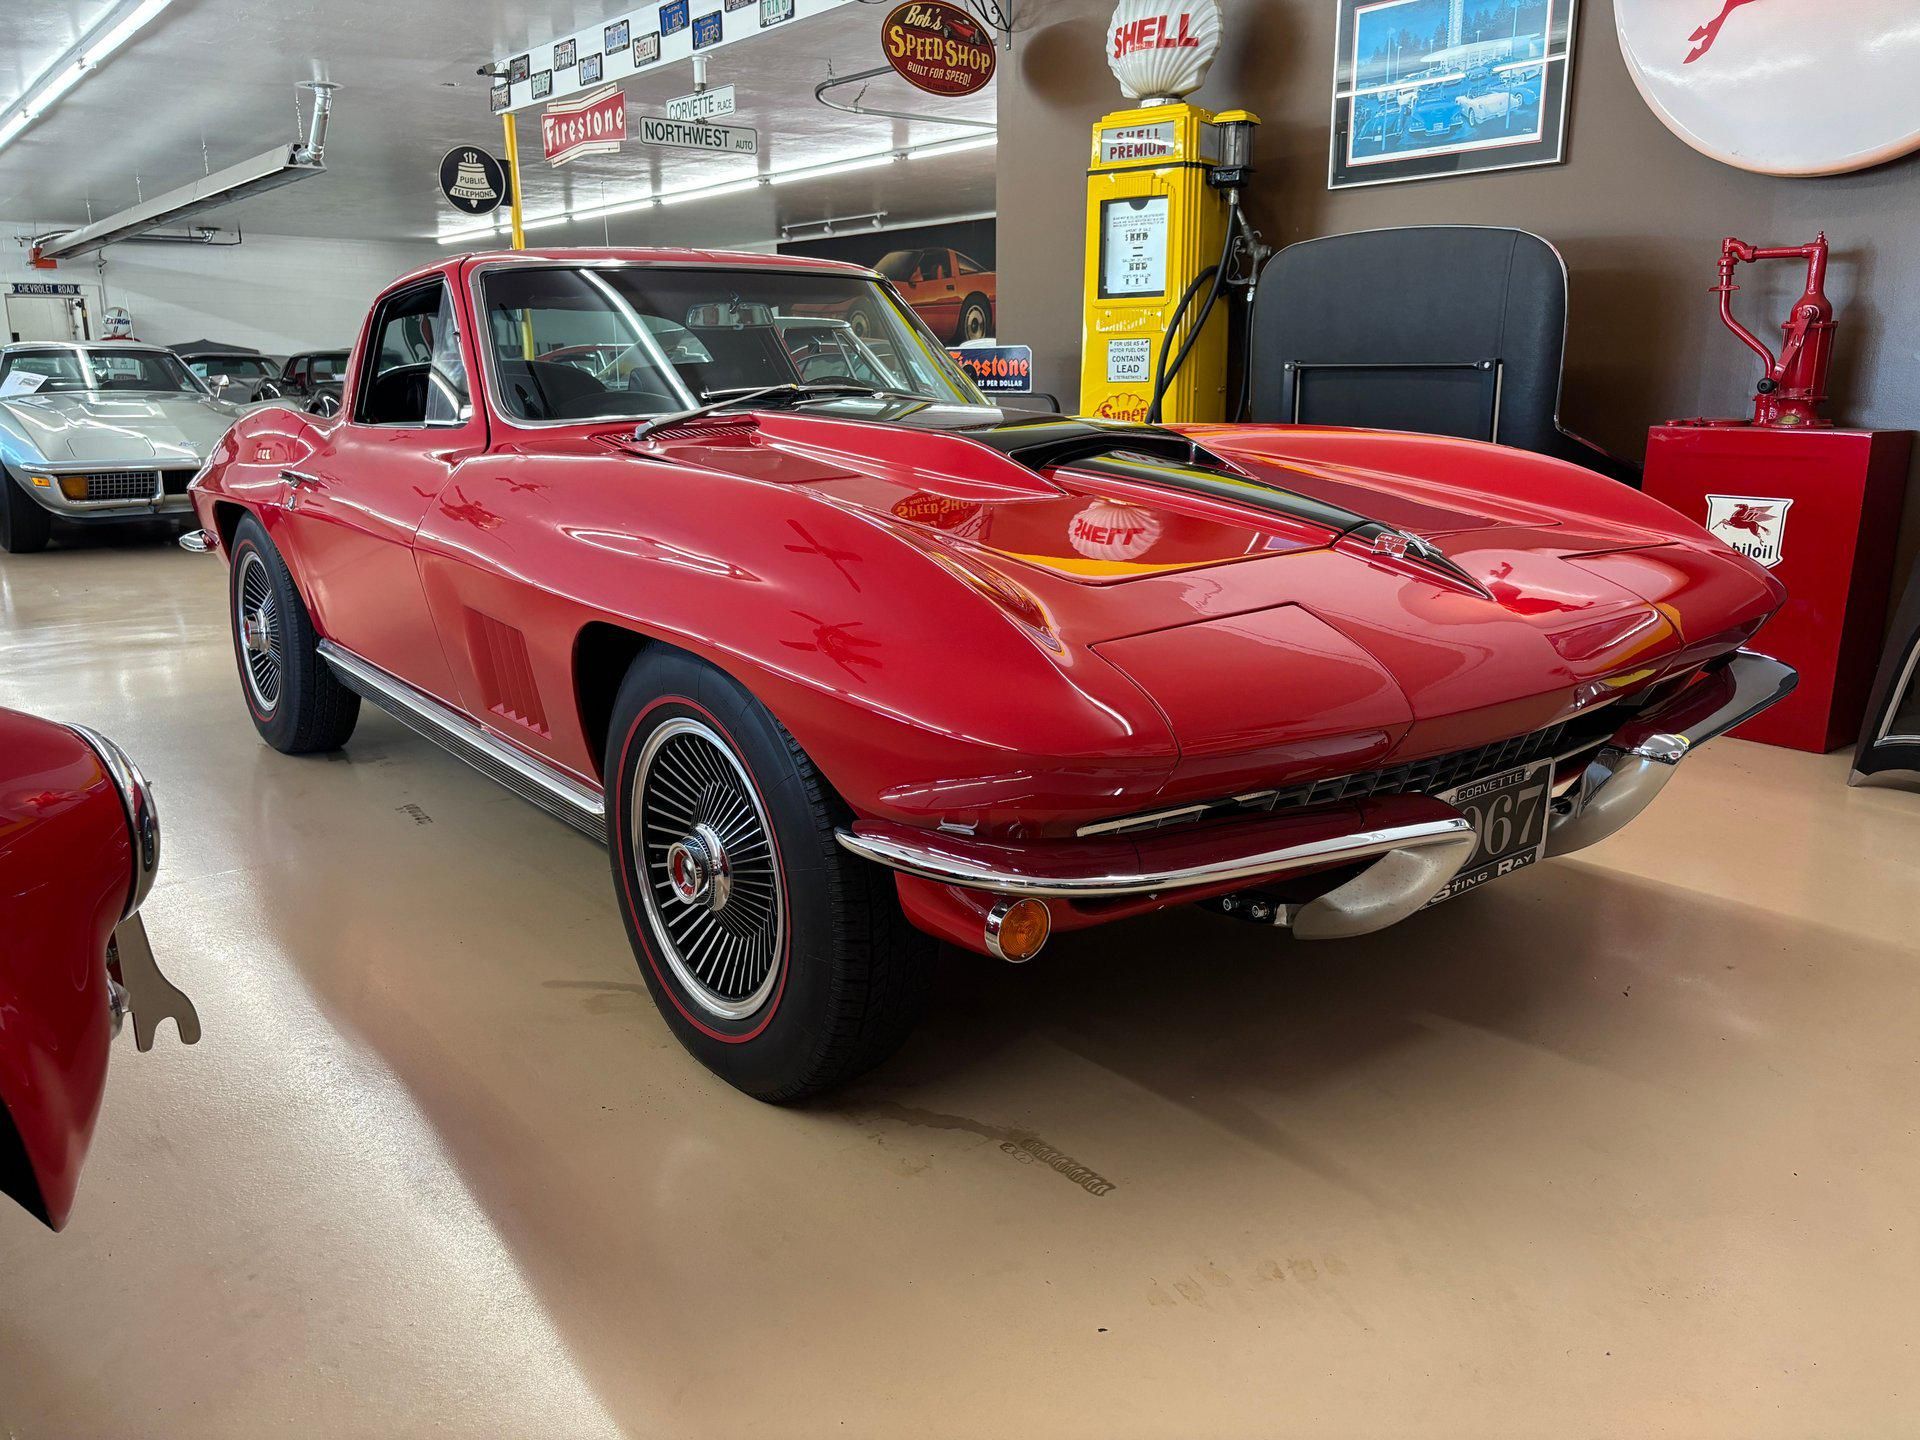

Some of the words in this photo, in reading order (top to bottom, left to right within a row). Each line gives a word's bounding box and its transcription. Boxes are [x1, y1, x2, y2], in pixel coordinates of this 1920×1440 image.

[904, 5, 942, 30] Bob's
[635, 38, 657, 59] SHELLY
[1114, 13, 1199, 59] SHELL
[889, 25, 943, 61] SPEED
[945, 40, 991, 74] SHOP
[907, 61, 927, 76] BUILT
[928, 67, 944, 80] FOR
[945, 70, 972, 87] SPEED!
[669, 95, 714, 120] CORVETTE
[717, 100, 733, 110] PLACE
[544, 105, 625, 153] Firestone
[645, 121, 730, 148] NORTHWEST
[736, 139, 754, 151] AUTO
[1110, 144, 1167, 160] PREMIUM
[453, 187, 494, 198] TELEPHONE
[460, 176, 486, 185] PUBLIC
[18, 285, 54, 294] CHEVROLET
[58, 285, 75, 294] ROAD
[1112, 355, 1145, 363] CONTAINS
[1116, 365, 1140, 373] LEAD
[1458, 773, 1523, 801] CORVETTE
